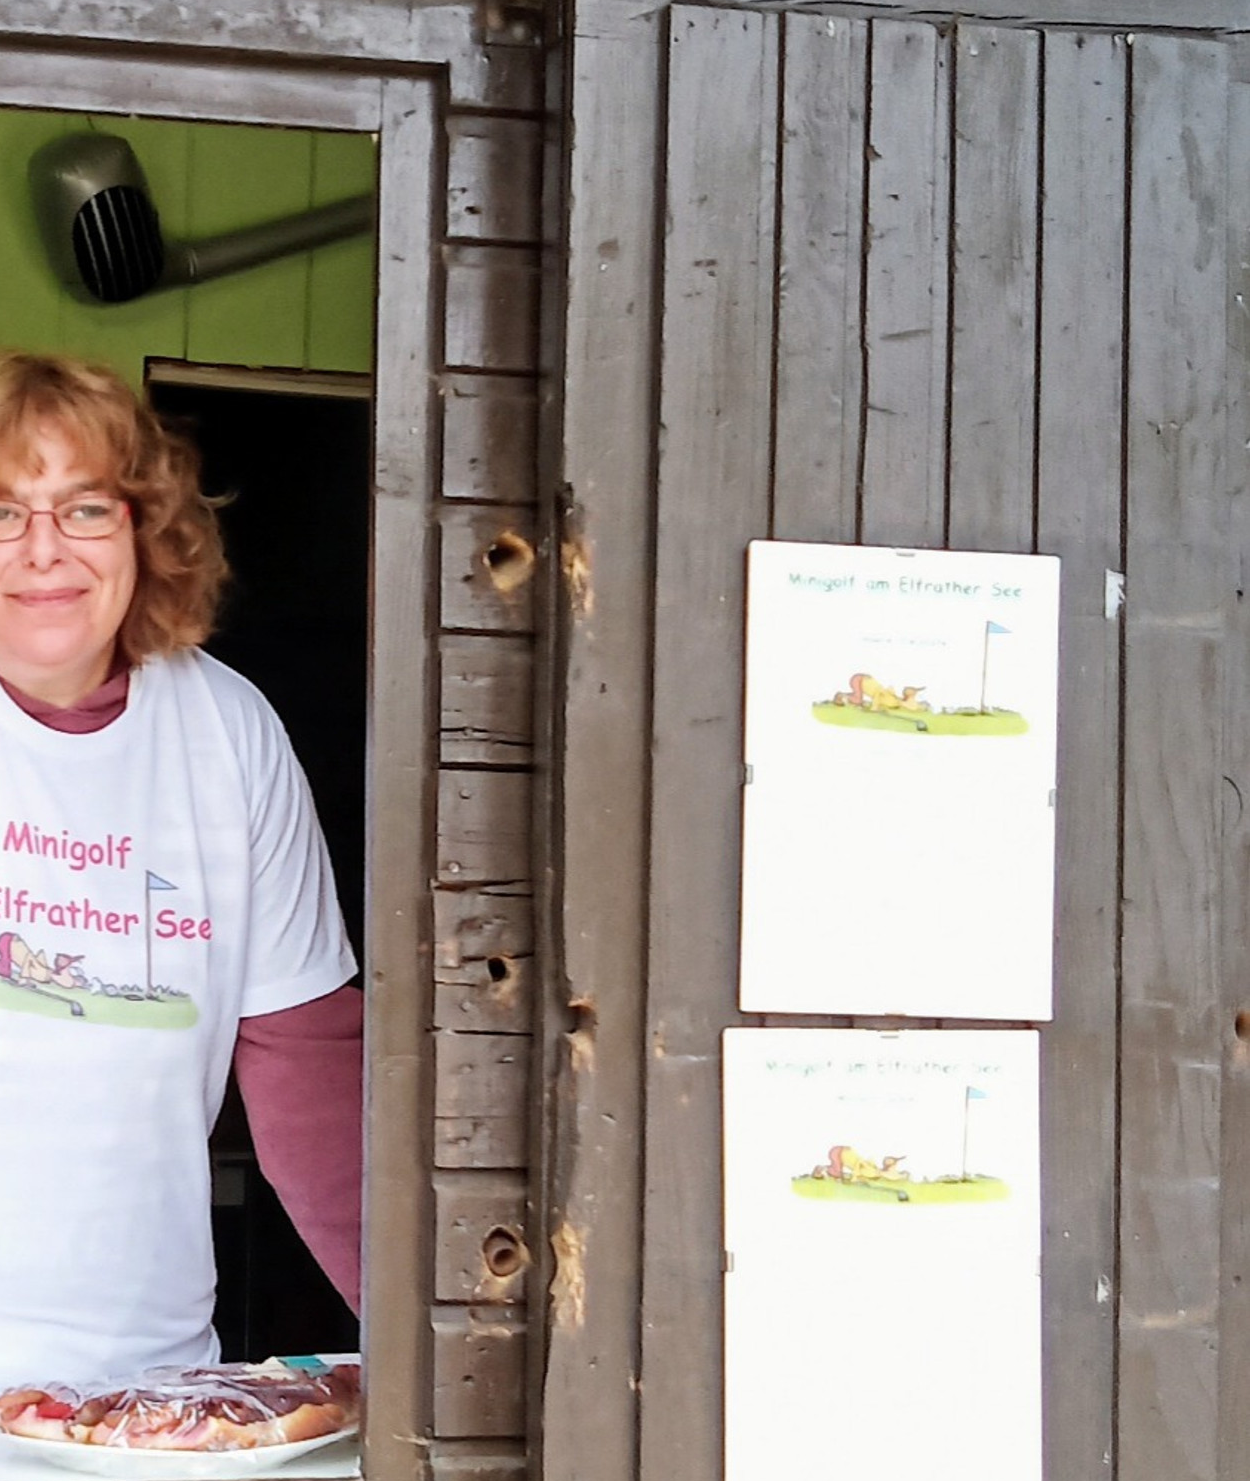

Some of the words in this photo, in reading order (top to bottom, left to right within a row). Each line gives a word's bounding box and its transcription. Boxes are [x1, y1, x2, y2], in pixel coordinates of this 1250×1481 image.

[866, 579, 890, 591] am
[992, 582, 1023, 598] See
[2, 820, 133, 871] Minigolf
[154, 909, 212, 940] See
